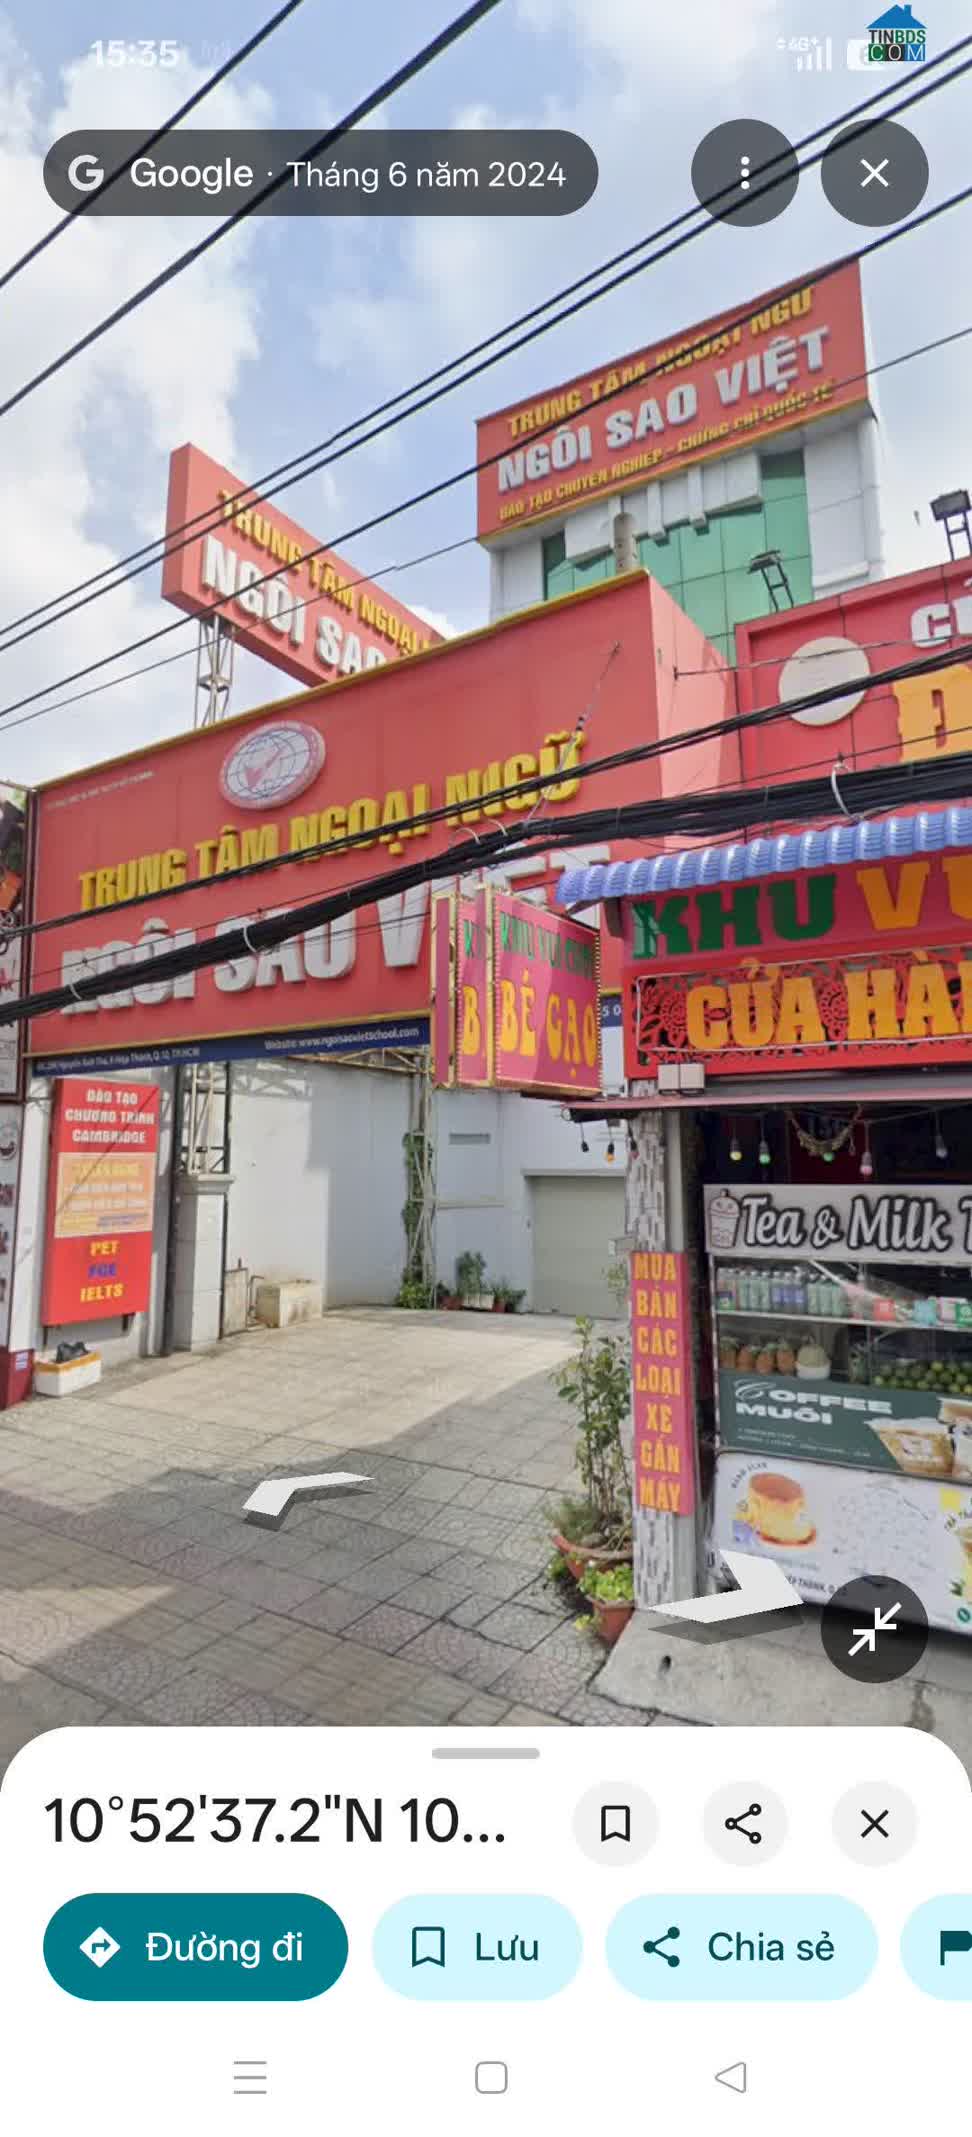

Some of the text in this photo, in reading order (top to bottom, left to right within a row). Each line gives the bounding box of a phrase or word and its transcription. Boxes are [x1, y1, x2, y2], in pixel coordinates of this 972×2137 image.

[498, 326, 829, 493] NGÔI SAO VIỆT
[508, 392, 582, 438] TRUNG
[202, 534, 306, 648] NGÔI
[307, 556, 356, 611] TÂM
[79, 848, 189, 910] TRUNG
[194, 825, 280, 878] TÂM
[289, 784, 432, 863] NGOẠI
[632, 874, 837, 959] KHU
[500, 968, 536, 1056] BÉ
[686, 956, 827, 1050] CỬA
[844, 950, 972, 1040] HÀ
[742, 1193, 807, 1249] Tea
[810, 1204, 844, 1248] &
[848, 1195, 950, 1252] Milk
[634, 1253, 677, 1280] MUA
[80, 1283, 124, 1302] IELTS
[636, 1284, 678, 1319] BÁN
[636, 1321, 678, 1357] CÁC
[635, 1363, 681, 1399] LOẠI
[733, 1378, 893, 1415] COFFEE
[646, 1403, 673, 1433] XE
[640, 1476, 681, 1512] MÁY
